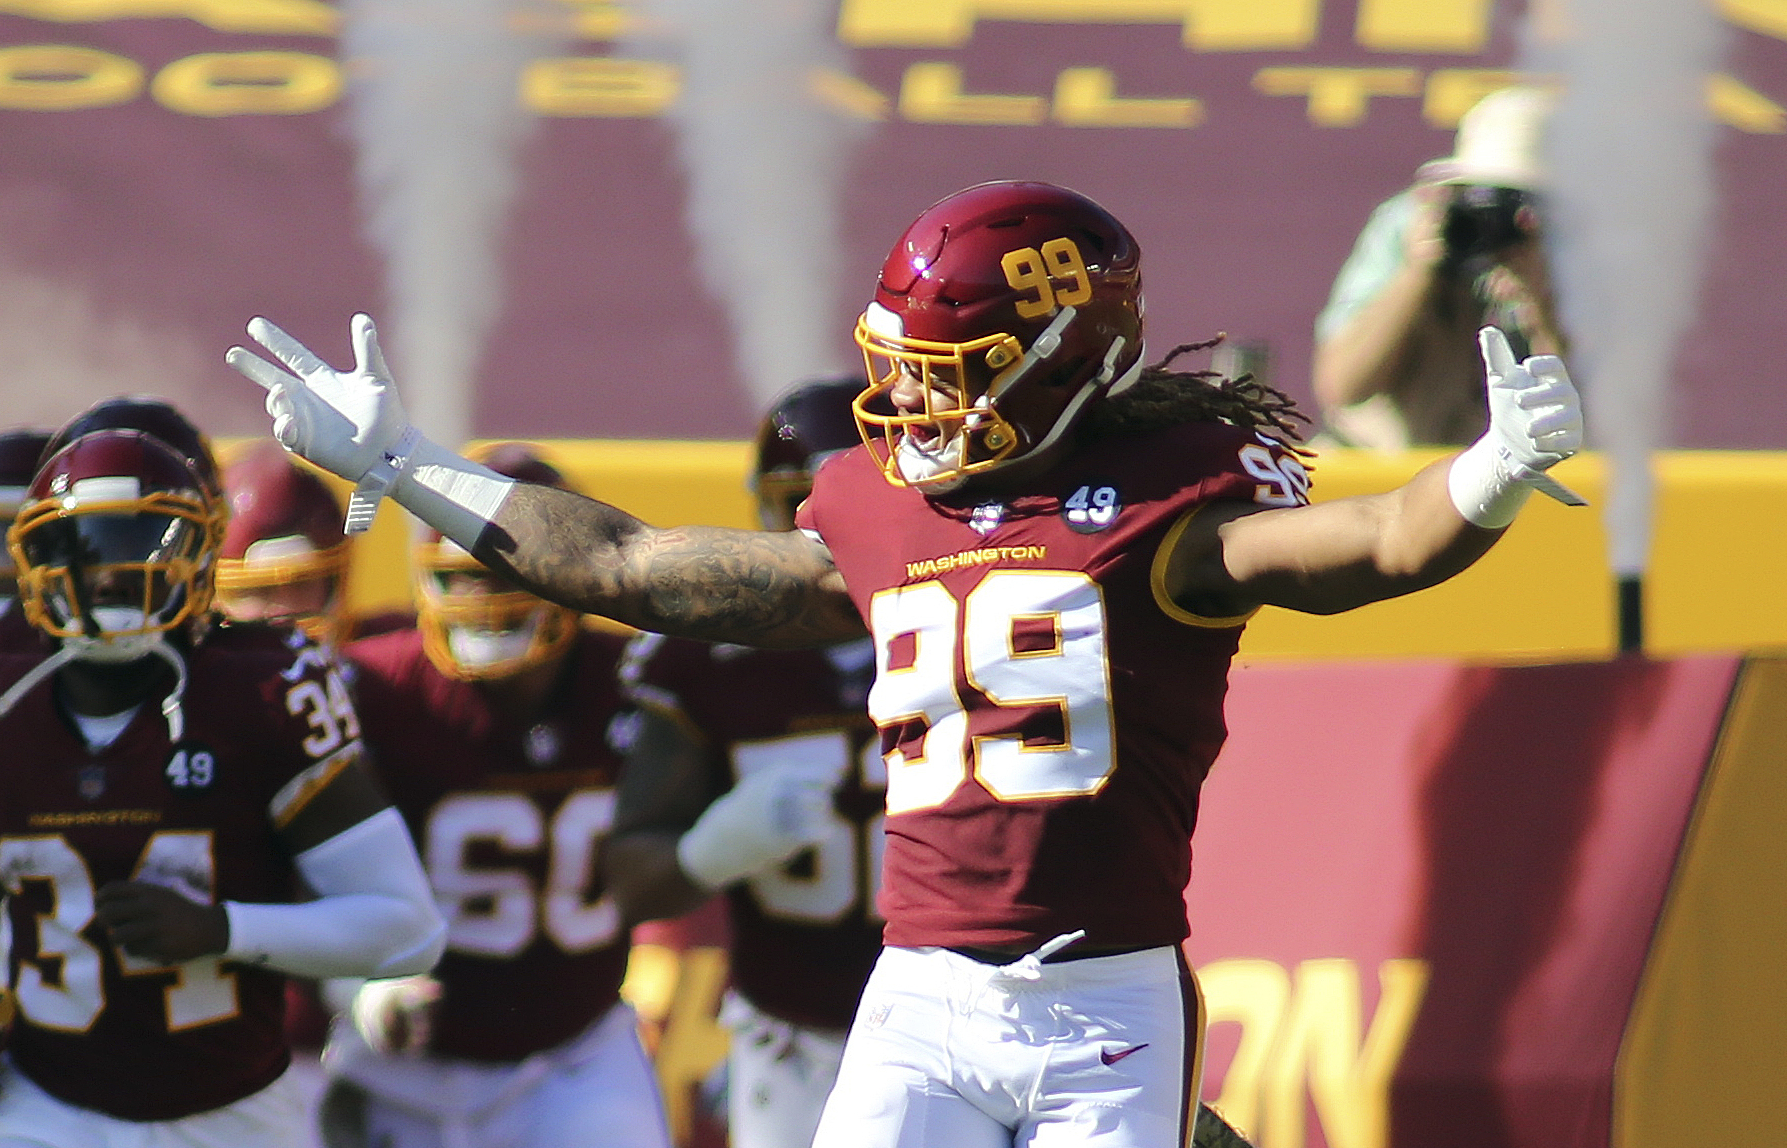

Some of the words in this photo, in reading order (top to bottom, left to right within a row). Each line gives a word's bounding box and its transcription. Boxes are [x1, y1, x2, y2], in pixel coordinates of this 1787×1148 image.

[1001, 237, 1092, 319] 99
[1064, 486, 1118, 524] 49
[906, 546, 1047, 578] WASHINGTON
[867, 568, 1118, 816] 99
[165, 750, 214, 788] 49
